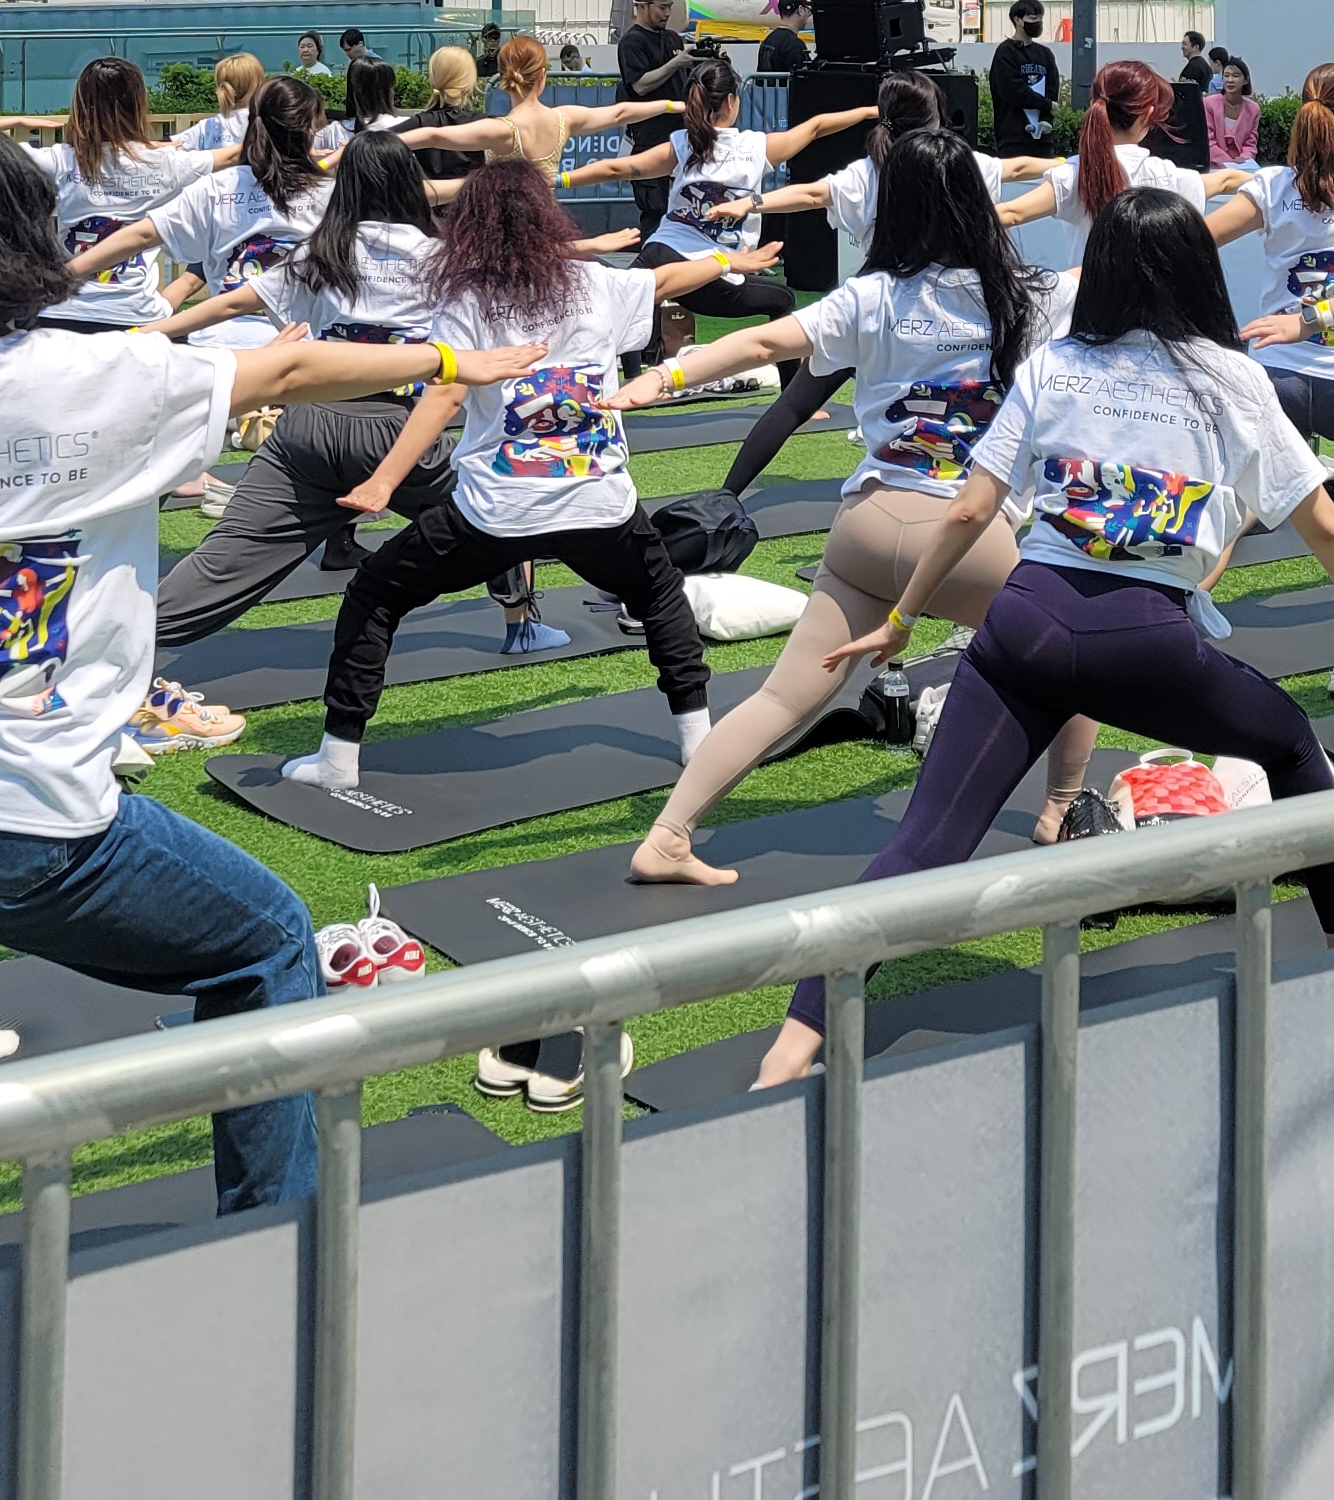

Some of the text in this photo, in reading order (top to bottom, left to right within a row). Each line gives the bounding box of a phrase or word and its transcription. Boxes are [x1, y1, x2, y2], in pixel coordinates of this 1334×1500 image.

[93, 189, 138, 197] CONFIDENCE
[1038, 374, 1224, 418] MERZ AESTHETICS
[1093, 404, 1219, 435] CONFIDENCE TO BE
[40, 470, 62, 485] TO
[68, 467, 89, 481] BE
